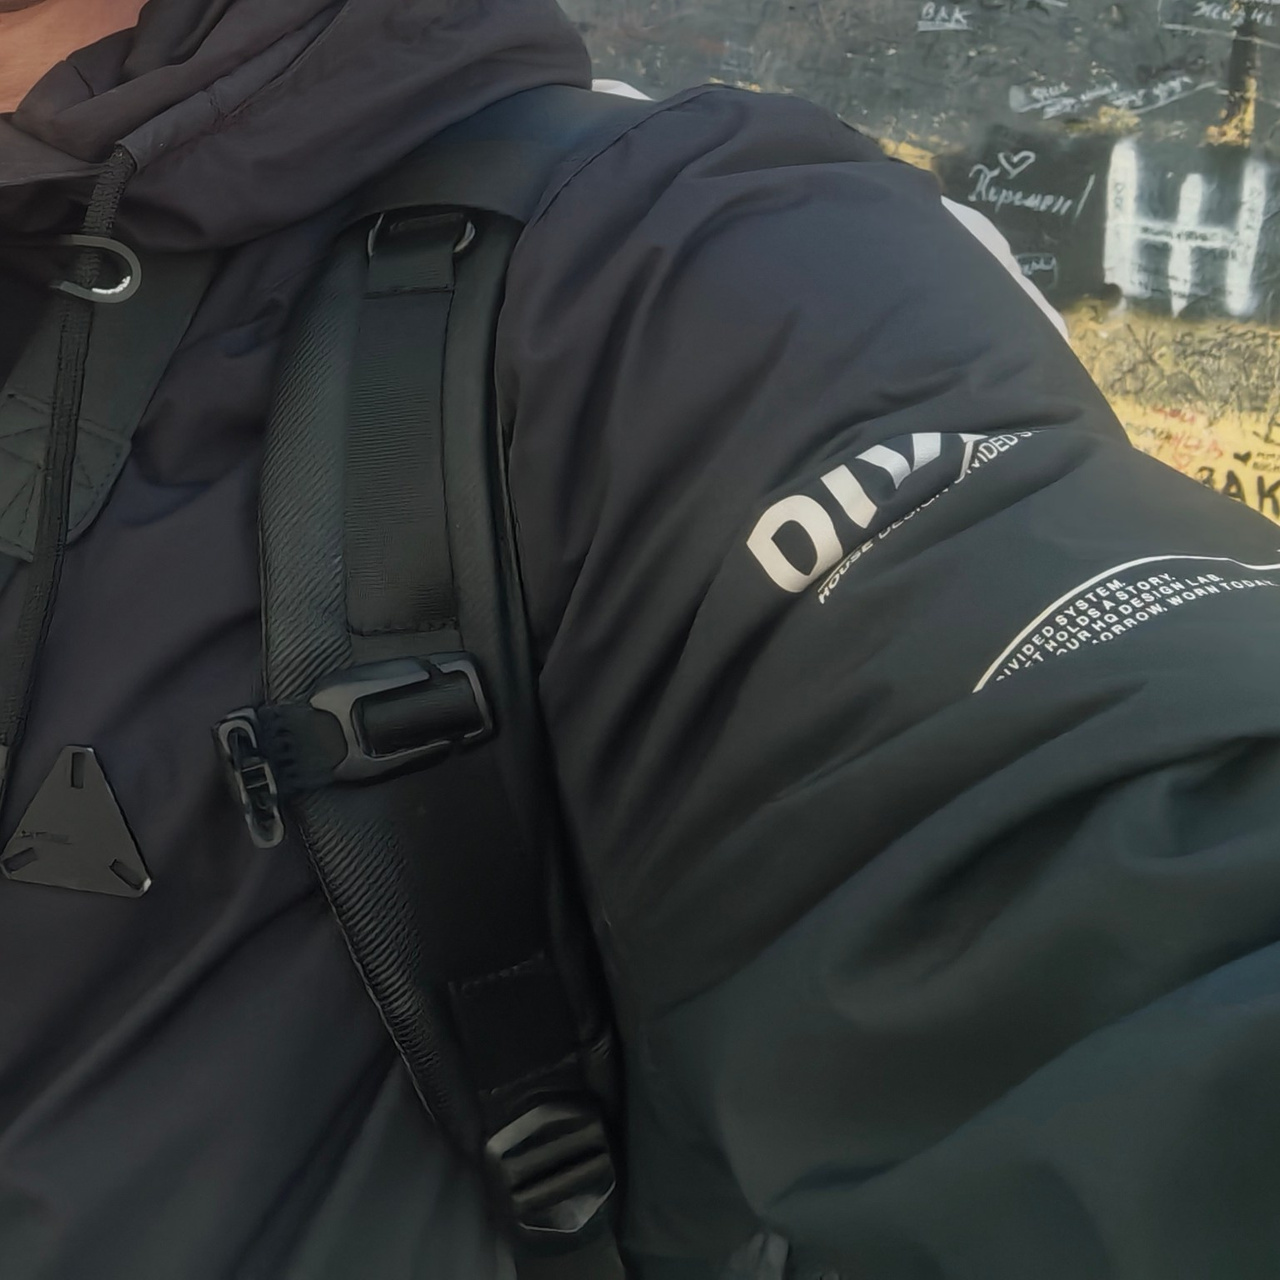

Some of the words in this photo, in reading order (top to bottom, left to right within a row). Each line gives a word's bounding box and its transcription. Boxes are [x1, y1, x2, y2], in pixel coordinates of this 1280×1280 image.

[1044, 607, 1102, 652] HOLDS
[1102, 599, 1116, 611] A
[1115, 573, 1176, 601] STORY.
[1055, 579, 1126, 626] SYSTEM.
[1091, 613, 1119, 631] HQ
[1118, 581, 1186, 615] DESIGN
[1166, 584, 1221, 606] WORN
